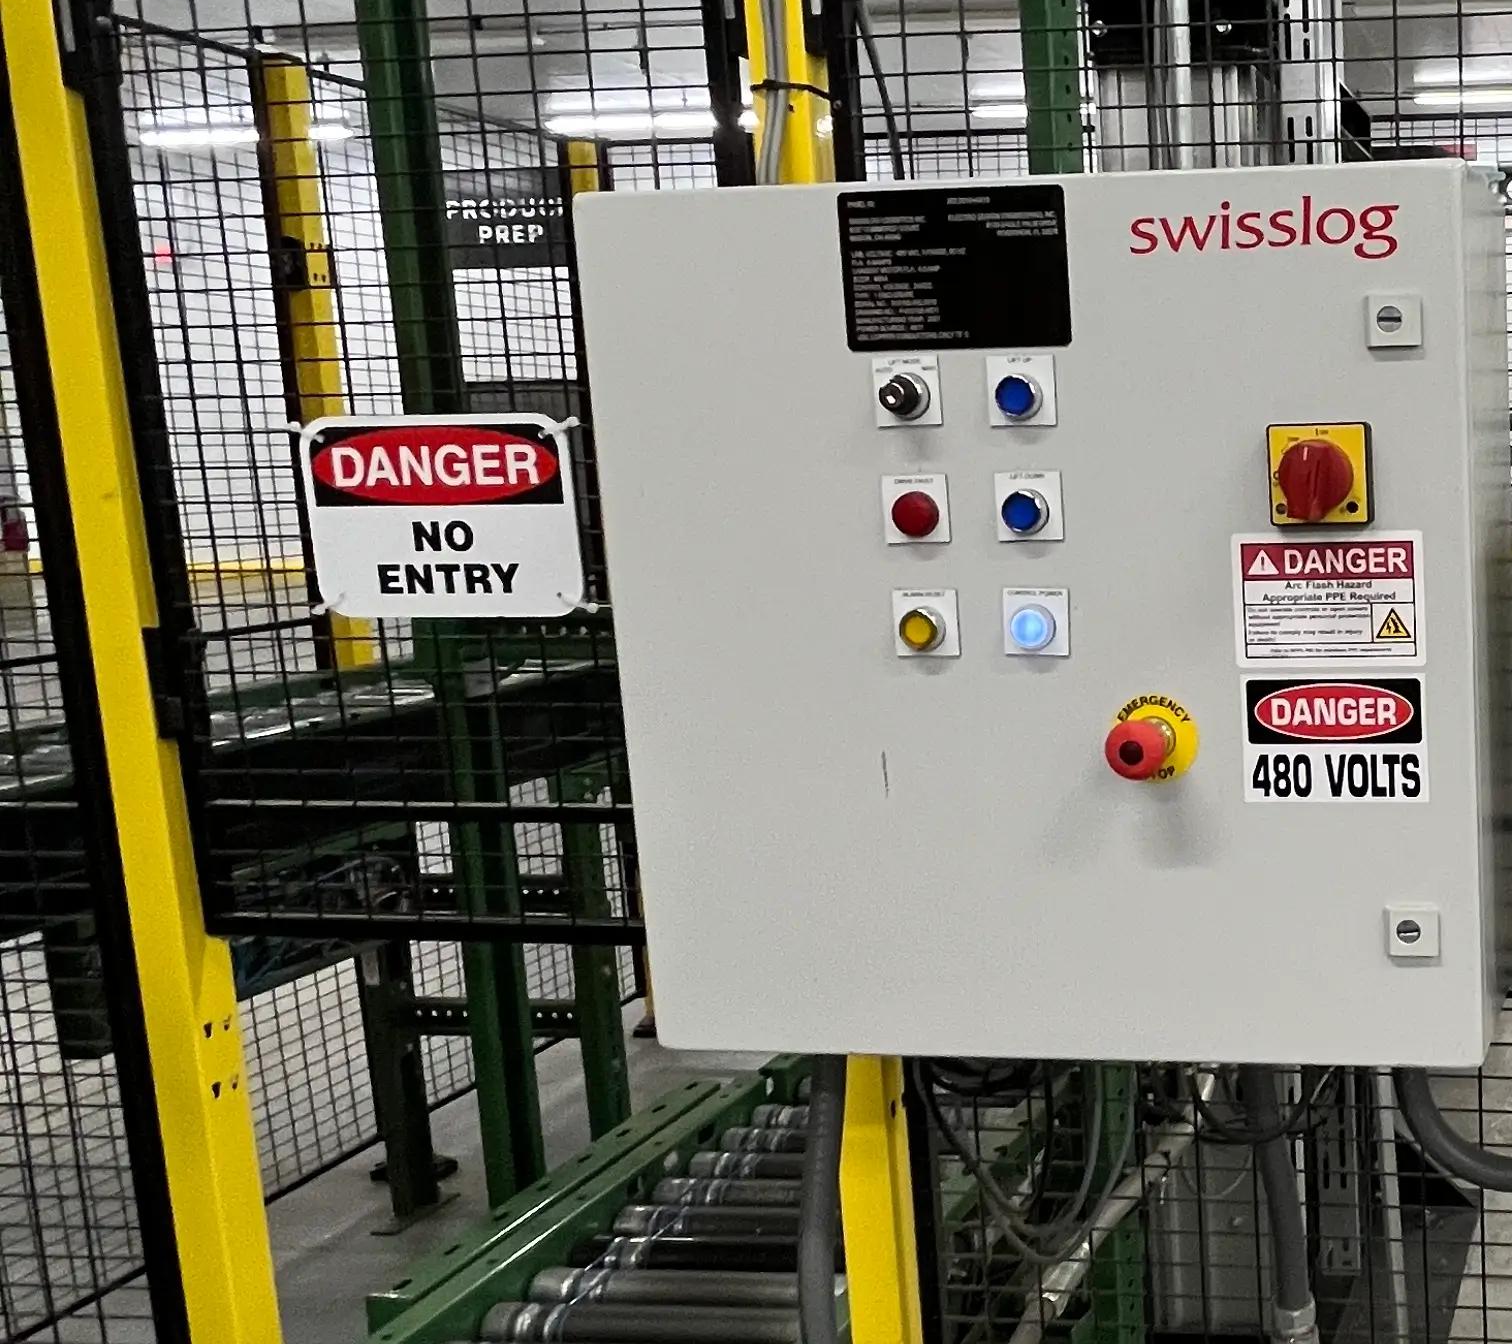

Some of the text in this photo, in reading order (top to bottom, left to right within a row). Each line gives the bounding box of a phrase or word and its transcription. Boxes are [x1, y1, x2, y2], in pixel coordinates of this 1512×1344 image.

[479, 224, 544, 244] PREP
[1130, 196, 1400, 259] swisslog
[330, 444, 541, 488] DANGER
[411, 520, 474, 552] NO
[1284, 548, 1408, 574] DANGER
[377, 563, 520, 594] ENTRY
[1285, 580, 1372, 590] Arc Flash Hazard
[1262, 591, 1396, 605] Appropriate PPE Required
[1117, 695, 1191, 723] EMERGENCY
[1271, 697, 1398, 727] DANGER
[1252, 753, 1421, 798] 480 VOLTS
